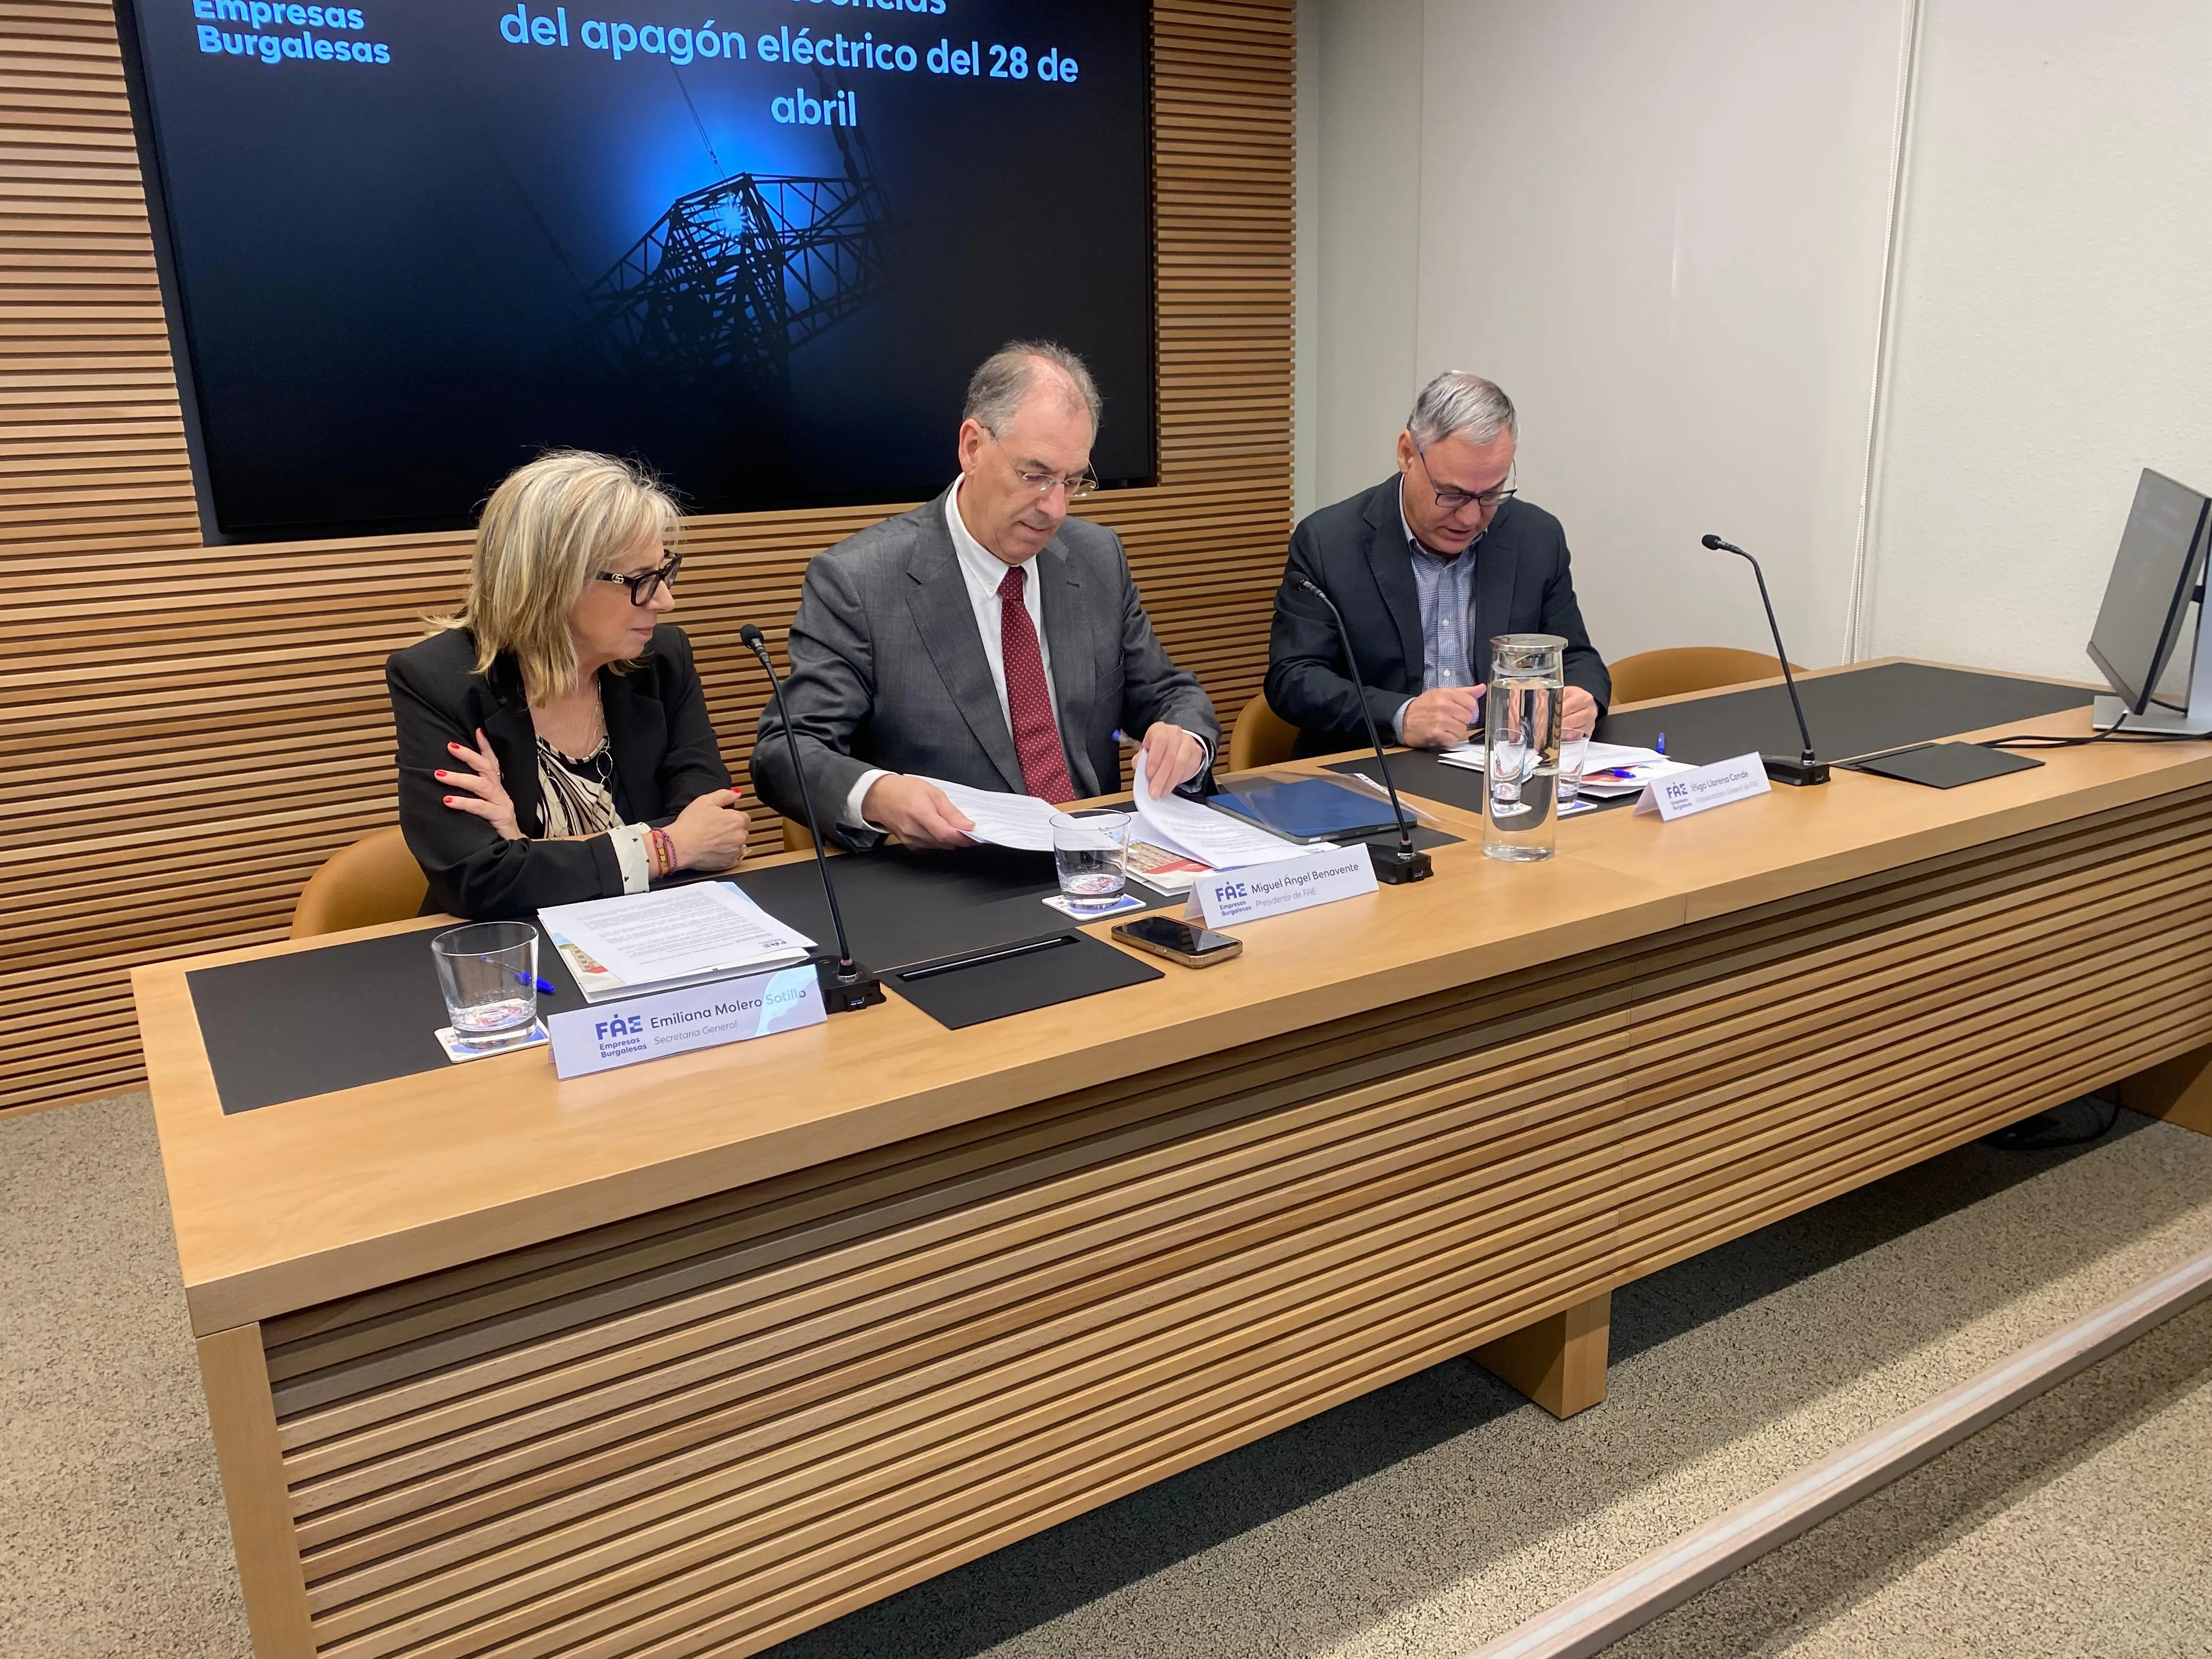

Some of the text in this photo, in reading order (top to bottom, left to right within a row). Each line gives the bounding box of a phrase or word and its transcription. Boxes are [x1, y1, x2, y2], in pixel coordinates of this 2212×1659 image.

[193, 0, 364, 30] Empresas
[196, 25, 390, 64] Burgalesas
[500, 3, 1078, 82] del apagón eléctrico del 28 de
[771, 88, 856, 127] abril
[1730, 770, 1749, 781] Conde
[1251, 863, 1359, 894] Miguel Ángel Benavente
[1220, 900, 1246, 911] Empresas
[1256, 887, 1316, 908] Presidente de FAE
[1221, 906, 1251, 917] Burgalesas
[651, 989, 806, 1029] Emiliana Molero Sotillo
[600, 1037, 640, 1052] Empresas
[654, 1020, 737, 1045] Secretaria General
[601, 1043, 647, 1059] Burgalesas
